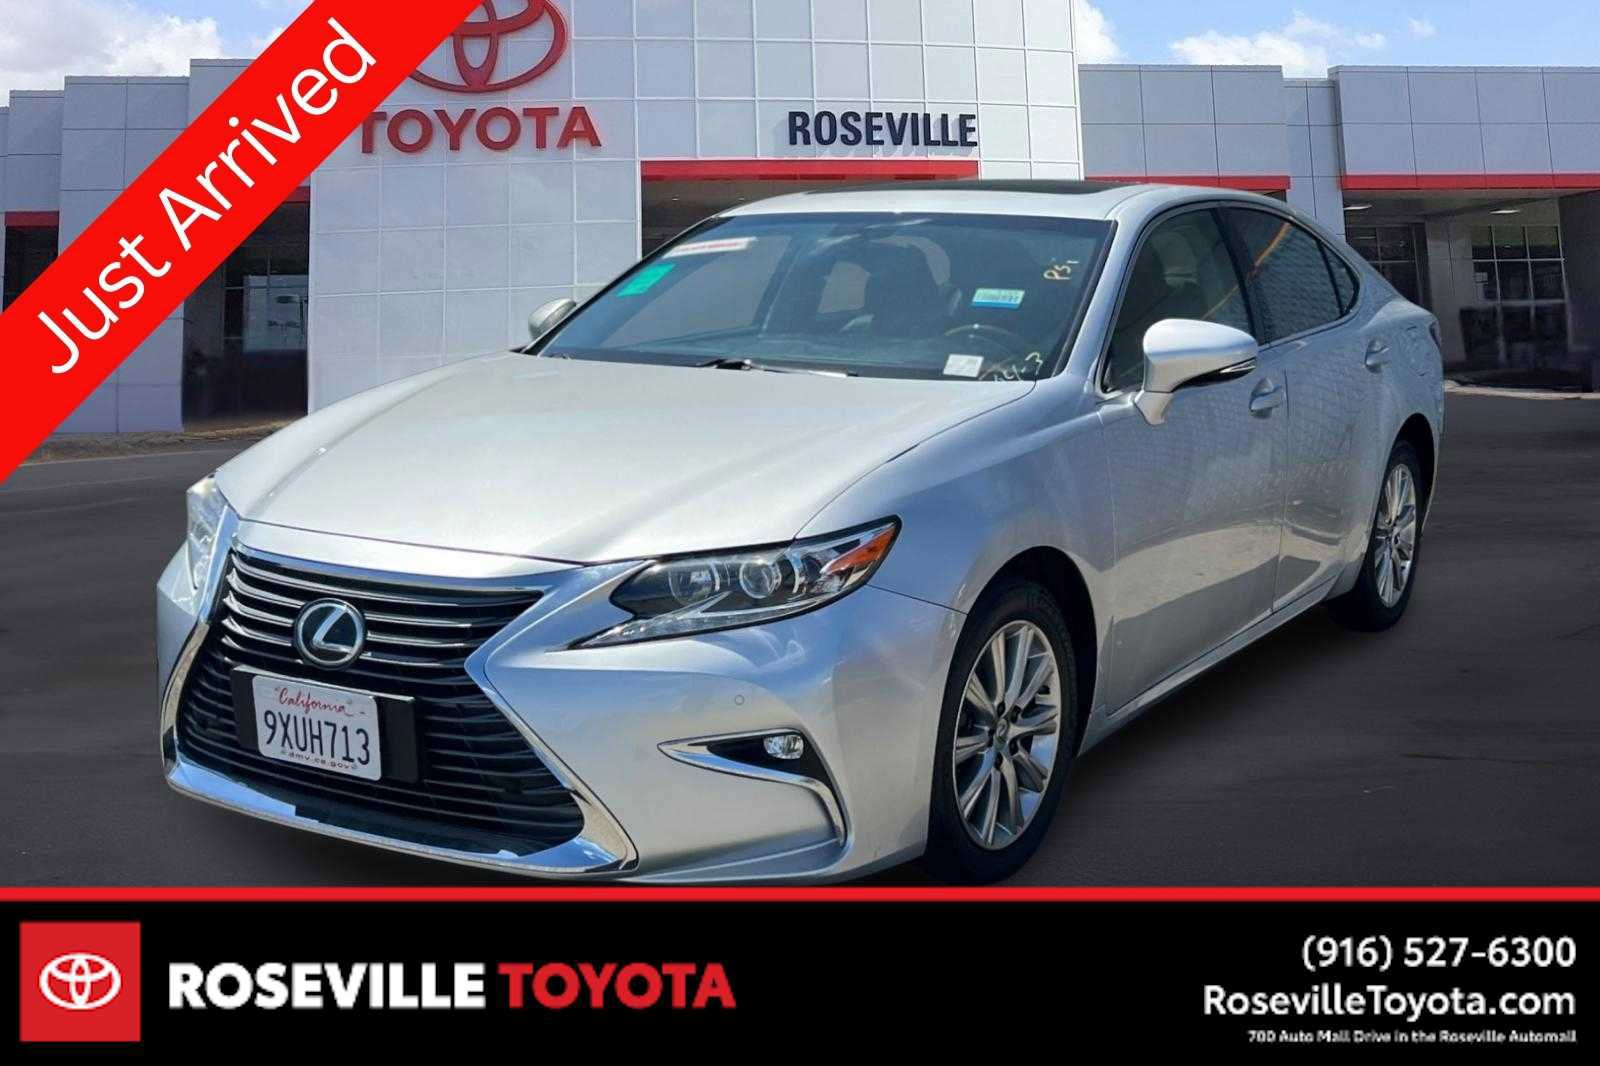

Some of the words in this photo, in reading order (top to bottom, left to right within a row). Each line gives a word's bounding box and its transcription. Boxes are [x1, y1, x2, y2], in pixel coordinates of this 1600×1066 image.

[361, 107, 602, 154] TOYOTA
[788, 111, 978, 147] ROSEVILLE
[278, 687, 354, 717] California
[263, 710, 371, 766] 9XUH713
[288, 752, 352, 770] dmv.ca.gov
